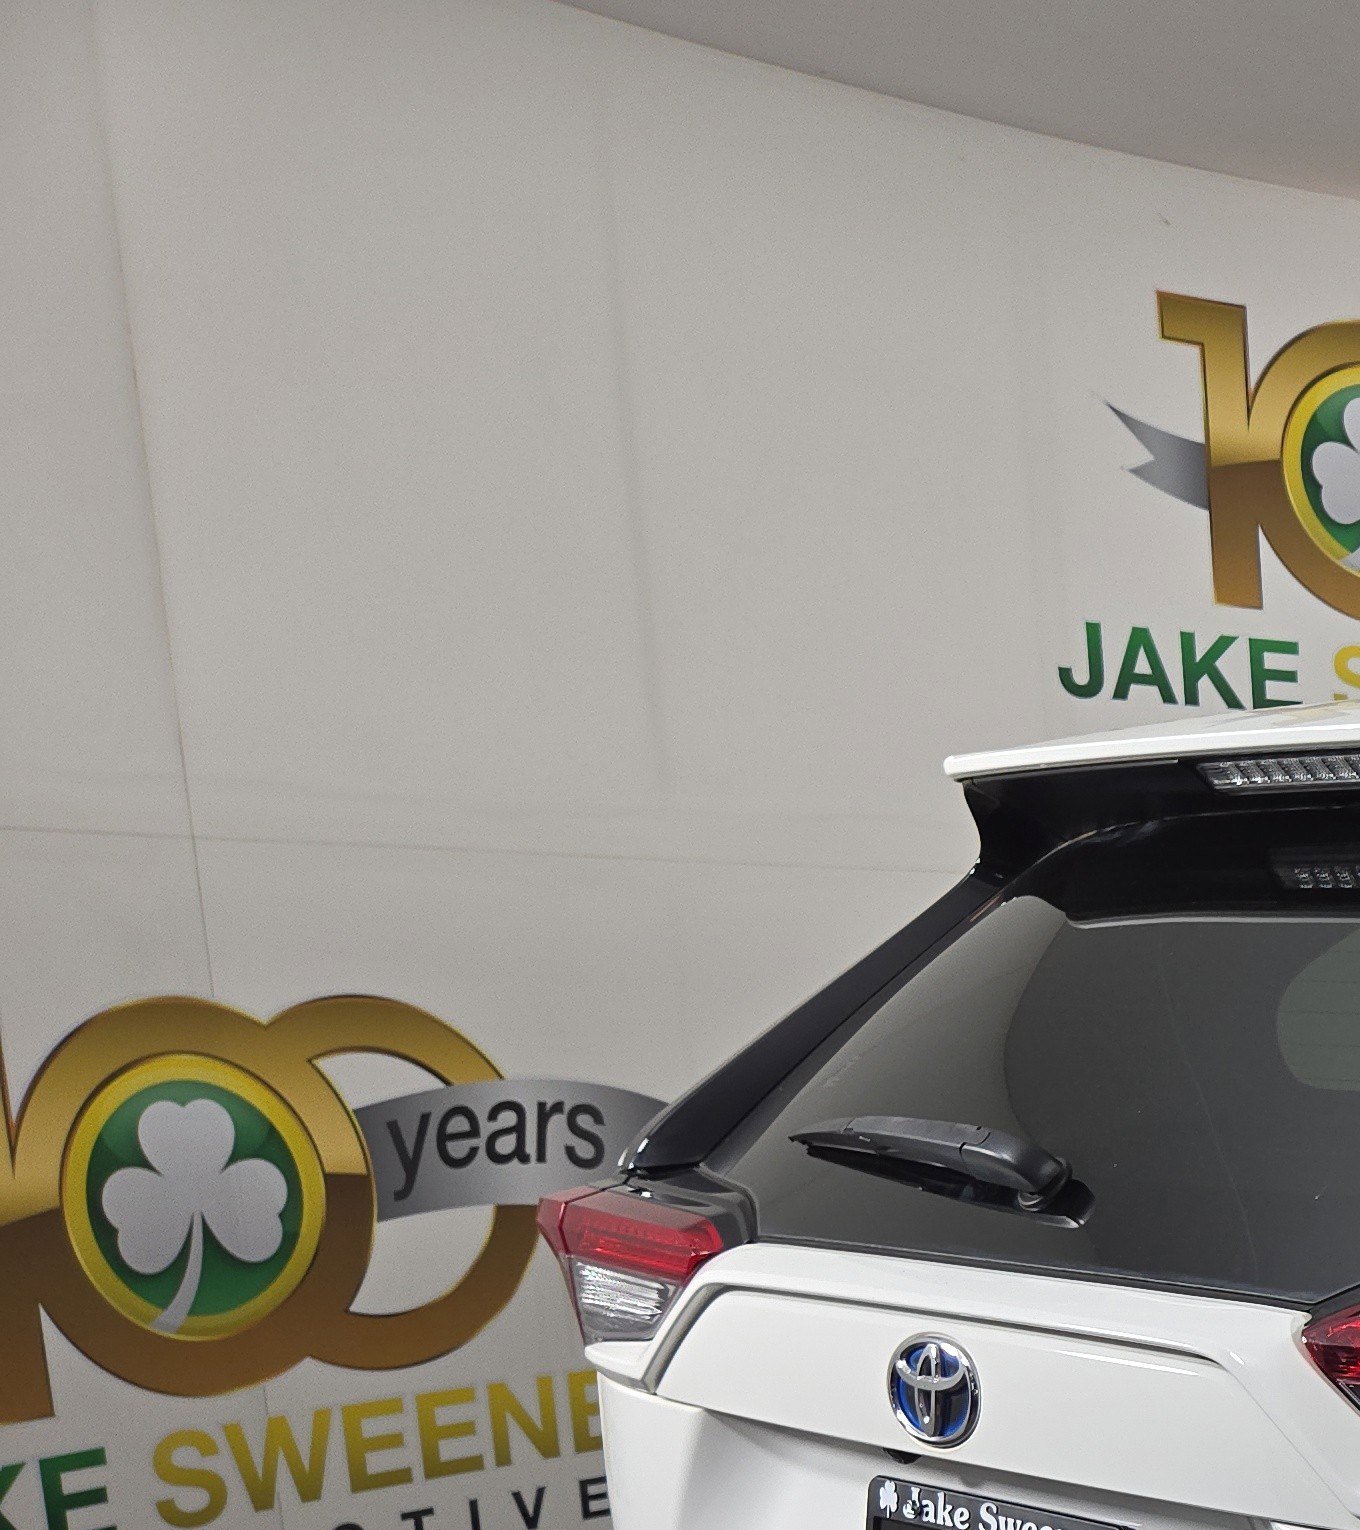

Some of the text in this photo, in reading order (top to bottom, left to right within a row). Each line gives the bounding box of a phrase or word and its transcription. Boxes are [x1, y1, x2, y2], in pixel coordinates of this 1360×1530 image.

[1057, 620, 1304, 710] JAKE
[385, 1098, 607, 1200] years
[152, 1368, 603, 1529] SWEENE
[902, 1486, 971, 1530] Jake
